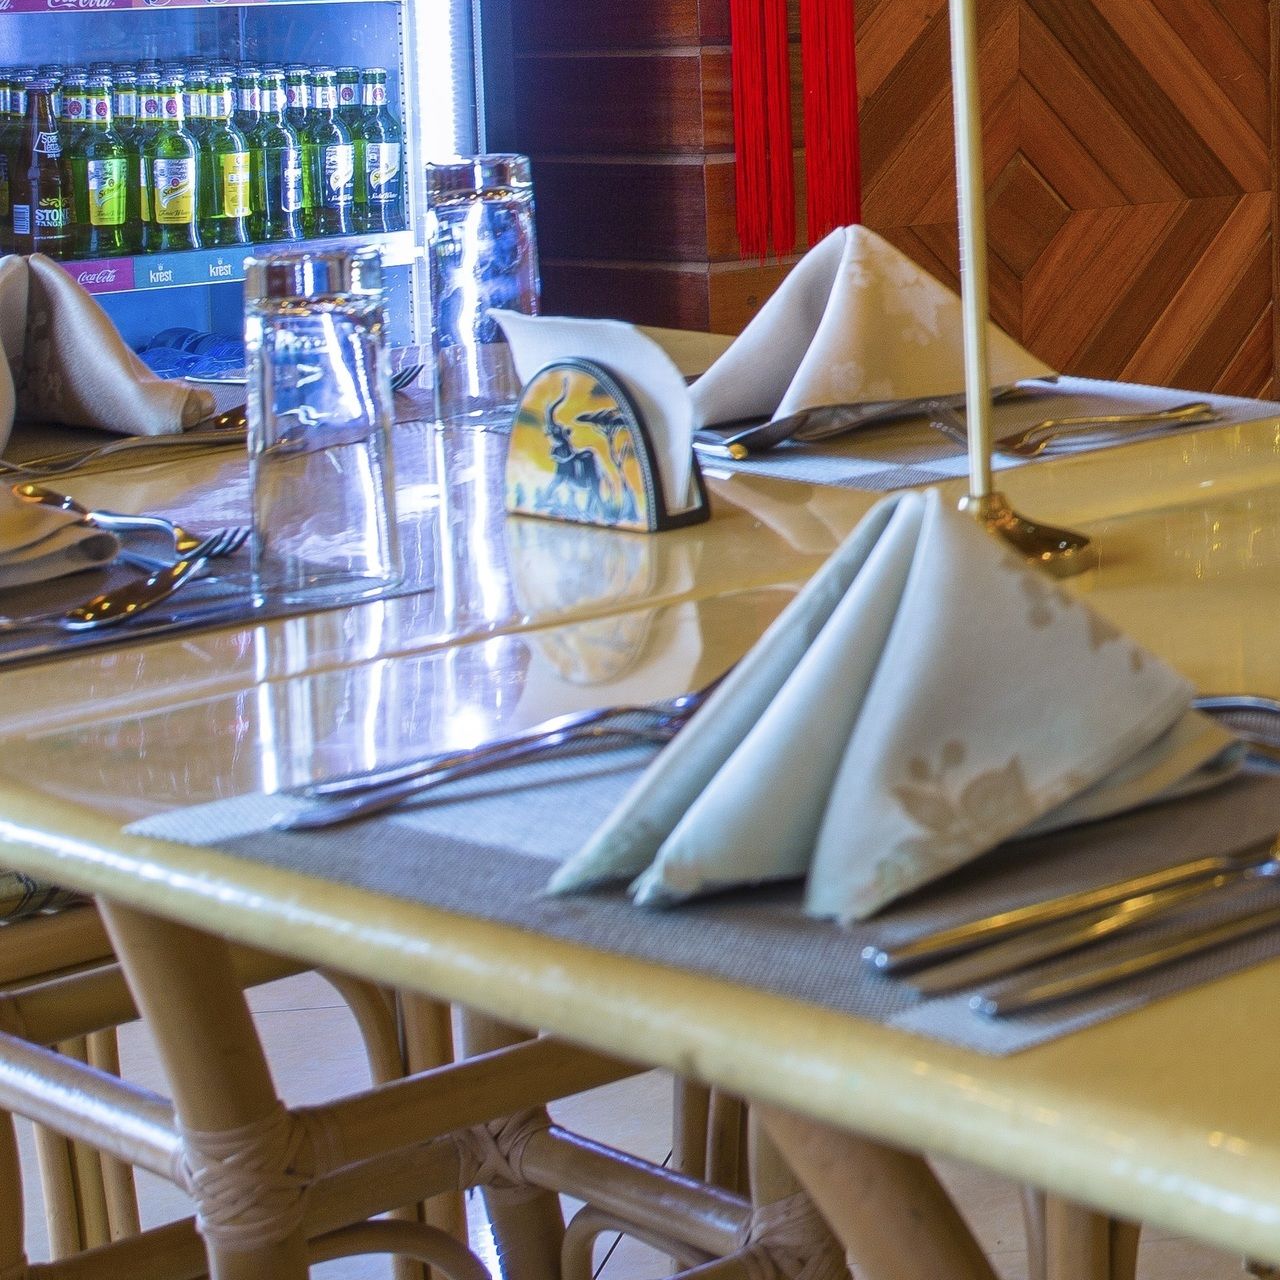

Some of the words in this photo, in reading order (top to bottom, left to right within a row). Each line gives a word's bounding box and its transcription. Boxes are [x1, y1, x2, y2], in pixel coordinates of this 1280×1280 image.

[77, 269, 119, 283] Coca-Cola
[150, 270, 172, 283] krest
[209, 264, 232, 277] krest
